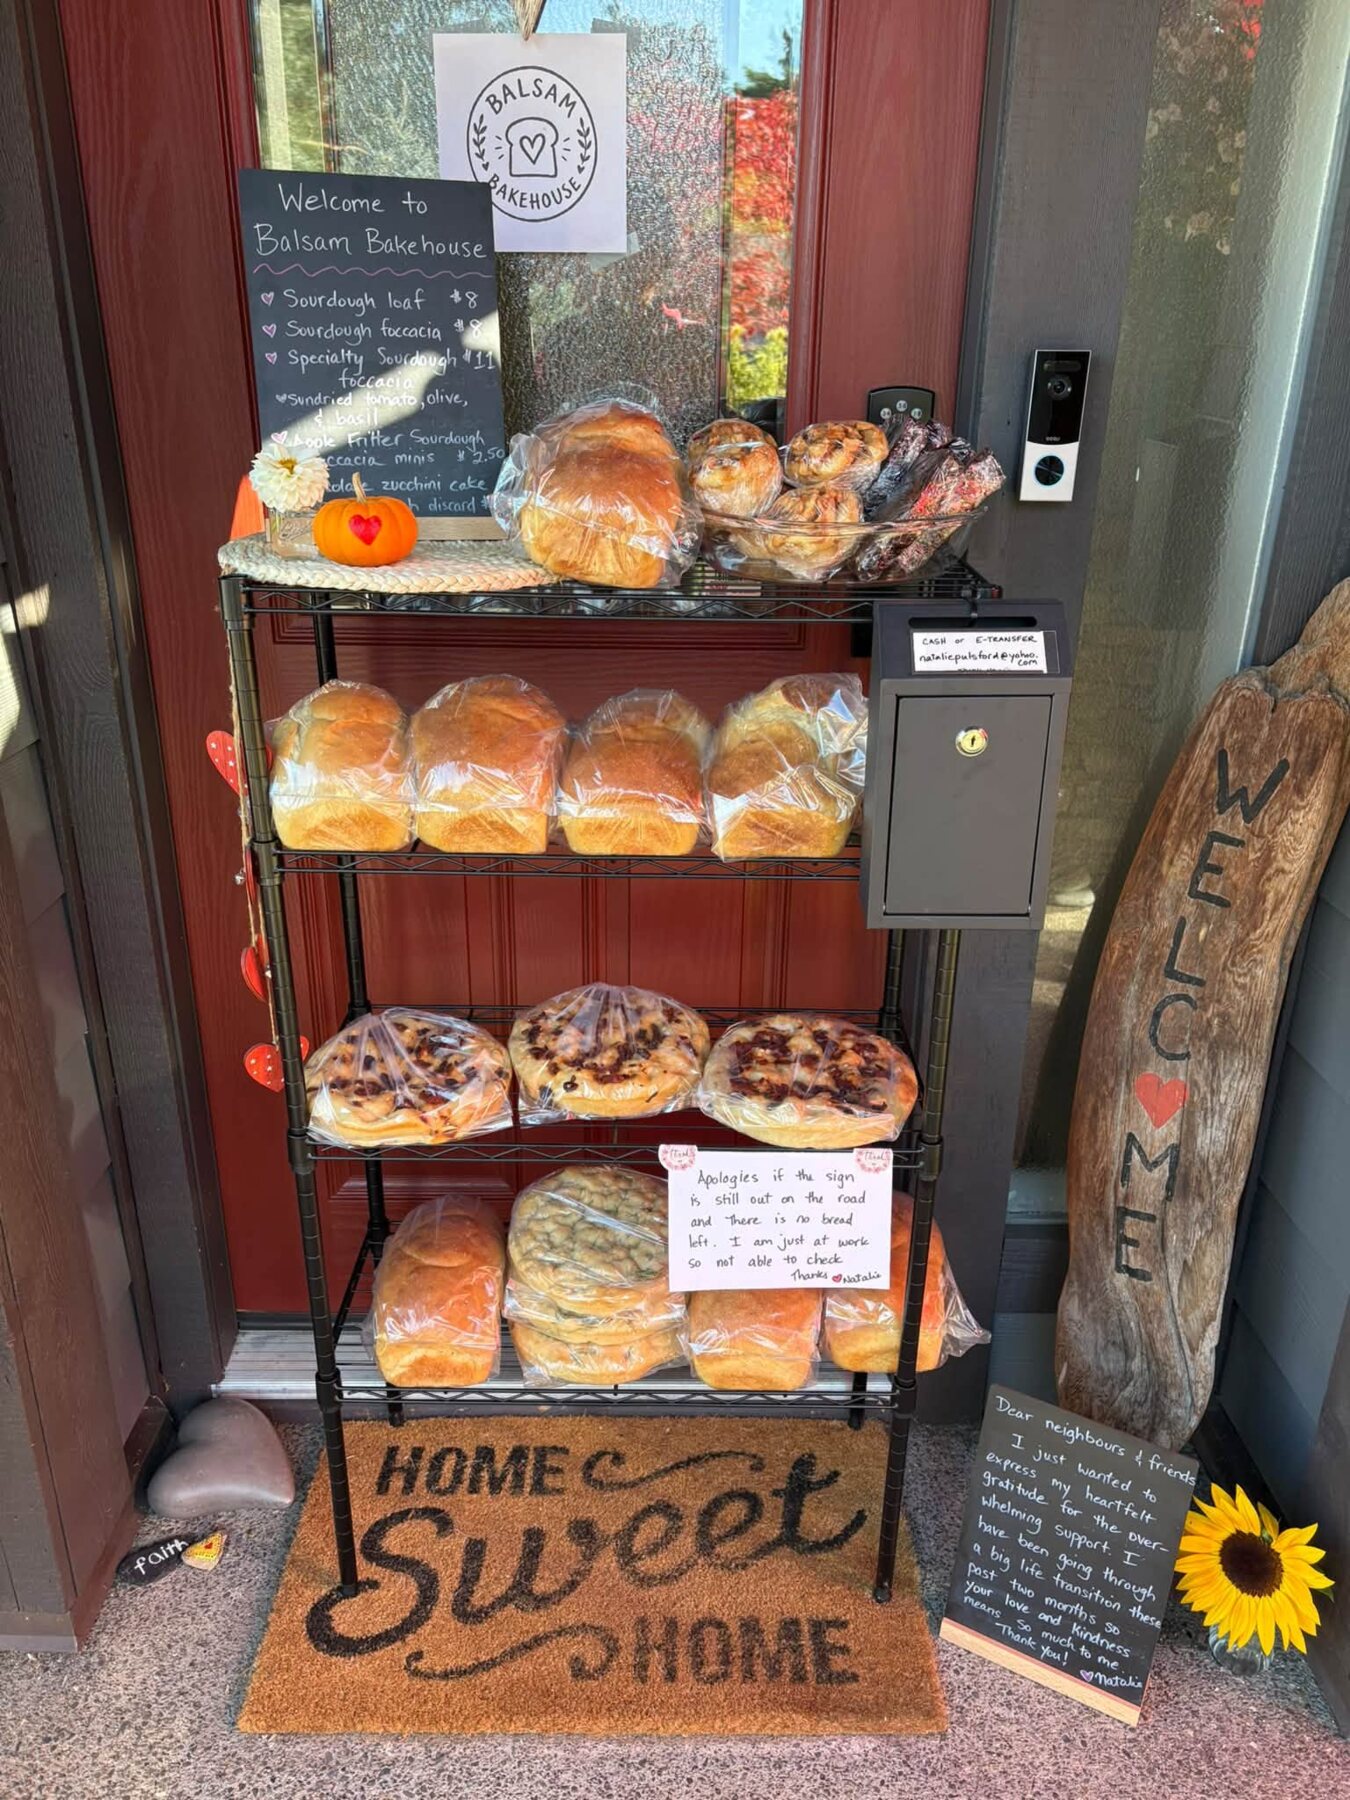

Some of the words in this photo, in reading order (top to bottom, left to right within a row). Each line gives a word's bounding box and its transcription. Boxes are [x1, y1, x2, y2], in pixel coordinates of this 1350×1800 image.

[485, 77, 577, 119] BALSAM
[278, 183, 386, 213] Welcome
[401, 191, 428, 214] to
[488, 173, 582, 210] BAKEHOUSE
[253, 223, 352, 257] Balsam
[365, 227, 488, 259] Bakehouse
[283, 288, 376, 317] Sourdough
[388, 287, 427, 311] loaf
[285, 319, 373, 347] Sourdough
[380, 317, 442, 342] foccacia
[288, 350, 364, 375] Specialty
[378, 346, 457, 376] Sourdough
[338, 372, 415, 390] foccacia
[287, 390, 353, 407] Sundried
[336, 408, 379, 426] basil
[347, 428, 404, 449] Fritter
[409, 427, 486, 453] Sourdough
[394, 447, 436, 466] minis
[381, 473, 442, 492] zucchini
[449, 474, 488, 492] cake
[428, 496, 477, 514] discard
[922, 637, 947, 646] CASH
[975, 635, 1038, 644] E-TRANSFER
[1018, 659, 1038, 667] com
[697, 1169, 760, 1190] Apologies
[773, 1168, 785, 1182] if
[795, 1168, 814, 1182] the
[825, 1170, 855, 1189] sign
[691, 1193, 701, 1207] is
[715, 1192, 740, 1206] still
[750, 1194, 773, 1204] out
[781, 1194, 795, 1204] on
[805, 1190, 824, 1204] the
[837, 1190, 866, 1204] road
[690, 1216, 712, 1227] and
[774, 1212, 786, 1224] is
[796, 1215, 810, 1224] no
[822, 1212, 854, 1226] bread
[689, 1234, 717, 1248] left.
[729, 1236, 741, 1247] I
[753, 1238, 773, 1248] am
[777, 1233, 805, 1251] just
[813, 1236, 830, 1246] at
[838, 1236, 870, 1248] work
[688, 1258, 702, 1269] so
[716, 1255, 735, 1267] not
[748, 1254, 773, 1267] able
[783, 1254, 797, 1265] to
[806, 1252, 844, 1265] check
[790, 1269, 828, 1282] Thanks
[842, 1271, 882, 1284] Natalie
[995, 1394, 1035, 1422] Dear
[1045, 1417, 1126, 1457] neighbours
[1149, 1455, 1197, 1487] friends
[376, 1445, 568, 1496] HOME
[1011, 1433, 1025, 1450] I
[1032, 1444, 1067, 1466] just
[1078, 1462, 1132, 1493] wanted
[1142, 1488, 1157, 1504] to
[986, 1451, 1038, 1479] express
[1051, 1478, 1071, 1499] my
[1085, 1485, 1157, 1524] heartfelt
[983, 1471, 1049, 1506] gratitude
[1060, 1500, 1083, 1518] for
[1093, 1510, 1122, 1535] the
[1128, 1531, 1170, 1553] over-
[981, 1494, 1043, 1535] whelming
[1054, 1524, 1112, 1557] support.
[1122, 1549, 1141, 1567] I
[134, 1539, 189, 1575] faith
[305, 1453, 868, 1658] Sweet
[978, 1515, 1009, 1540] have
[1017, 1533, 1049, 1557] been
[1058, 1552, 1093, 1581] going
[1102, 1567, 1156, 1602] through
[973, 1543, 982, 1556] a
[990, 1543, 1011, 1573] big
[1020, 1557, 1046, 1581] life
[1052, 1573, 1122, 1612] transition
[1128, 1605, 1162, 1630] these
[964, 1580, 994, 1598] your
[1004, 1593, 1031, 1615] love
[1037, 1610, 1062, 1627] and
[1009, 1578, 1035, 1599] two
[1044, 1596, 1097, 1625] months
[1105, 1621, 1121, 1637] so
[963, 1594, 1002, 1619] means
[1016, 1618, 1032, 1633] so
[1041, 1629, 1076, 1652] much
[1079, 1646, 1092, 1661] to
[995, 1621, 1037, 1650] Thank
[633, 1616, 860, 1686] HOME
